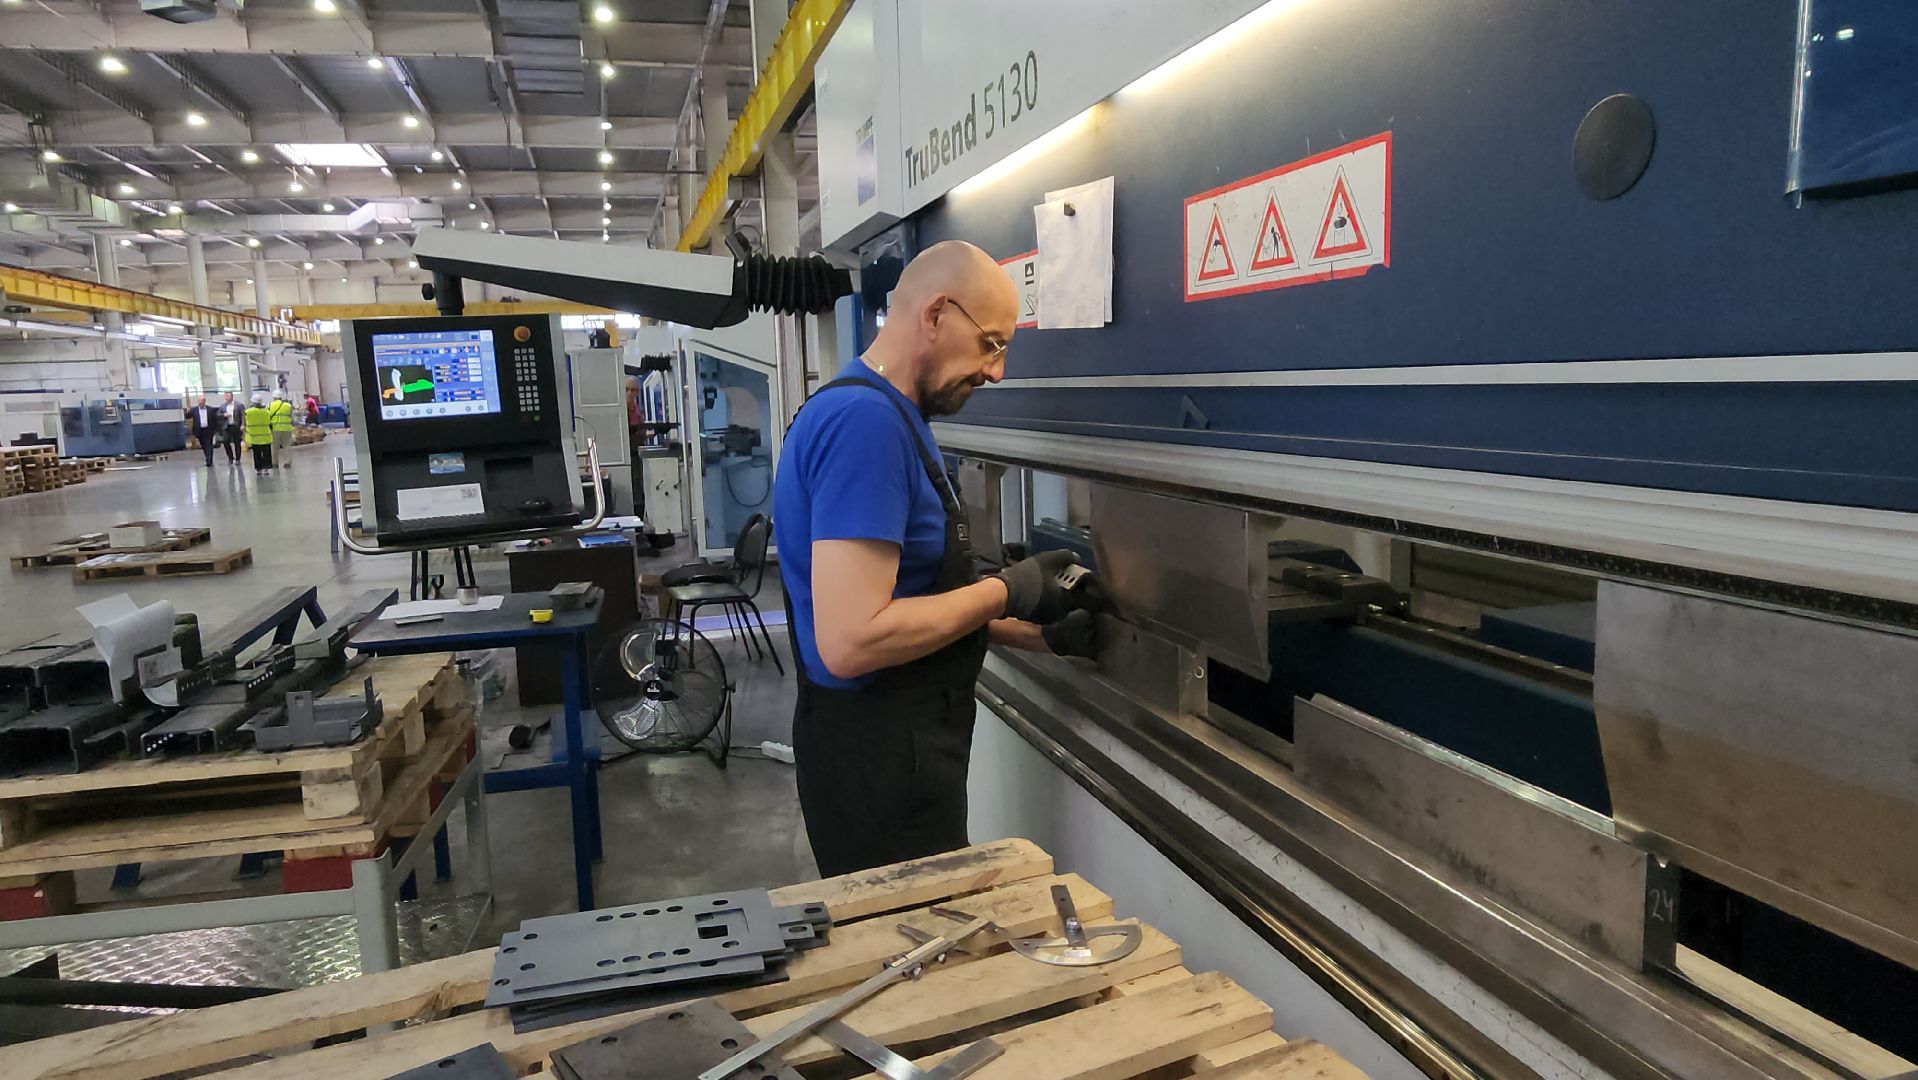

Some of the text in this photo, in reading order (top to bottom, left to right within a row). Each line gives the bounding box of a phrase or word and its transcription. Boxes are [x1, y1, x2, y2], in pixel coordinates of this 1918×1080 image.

[904, 50, 1038, 189] TruBend 5130
[1649, 887, 1674, 922] 24
